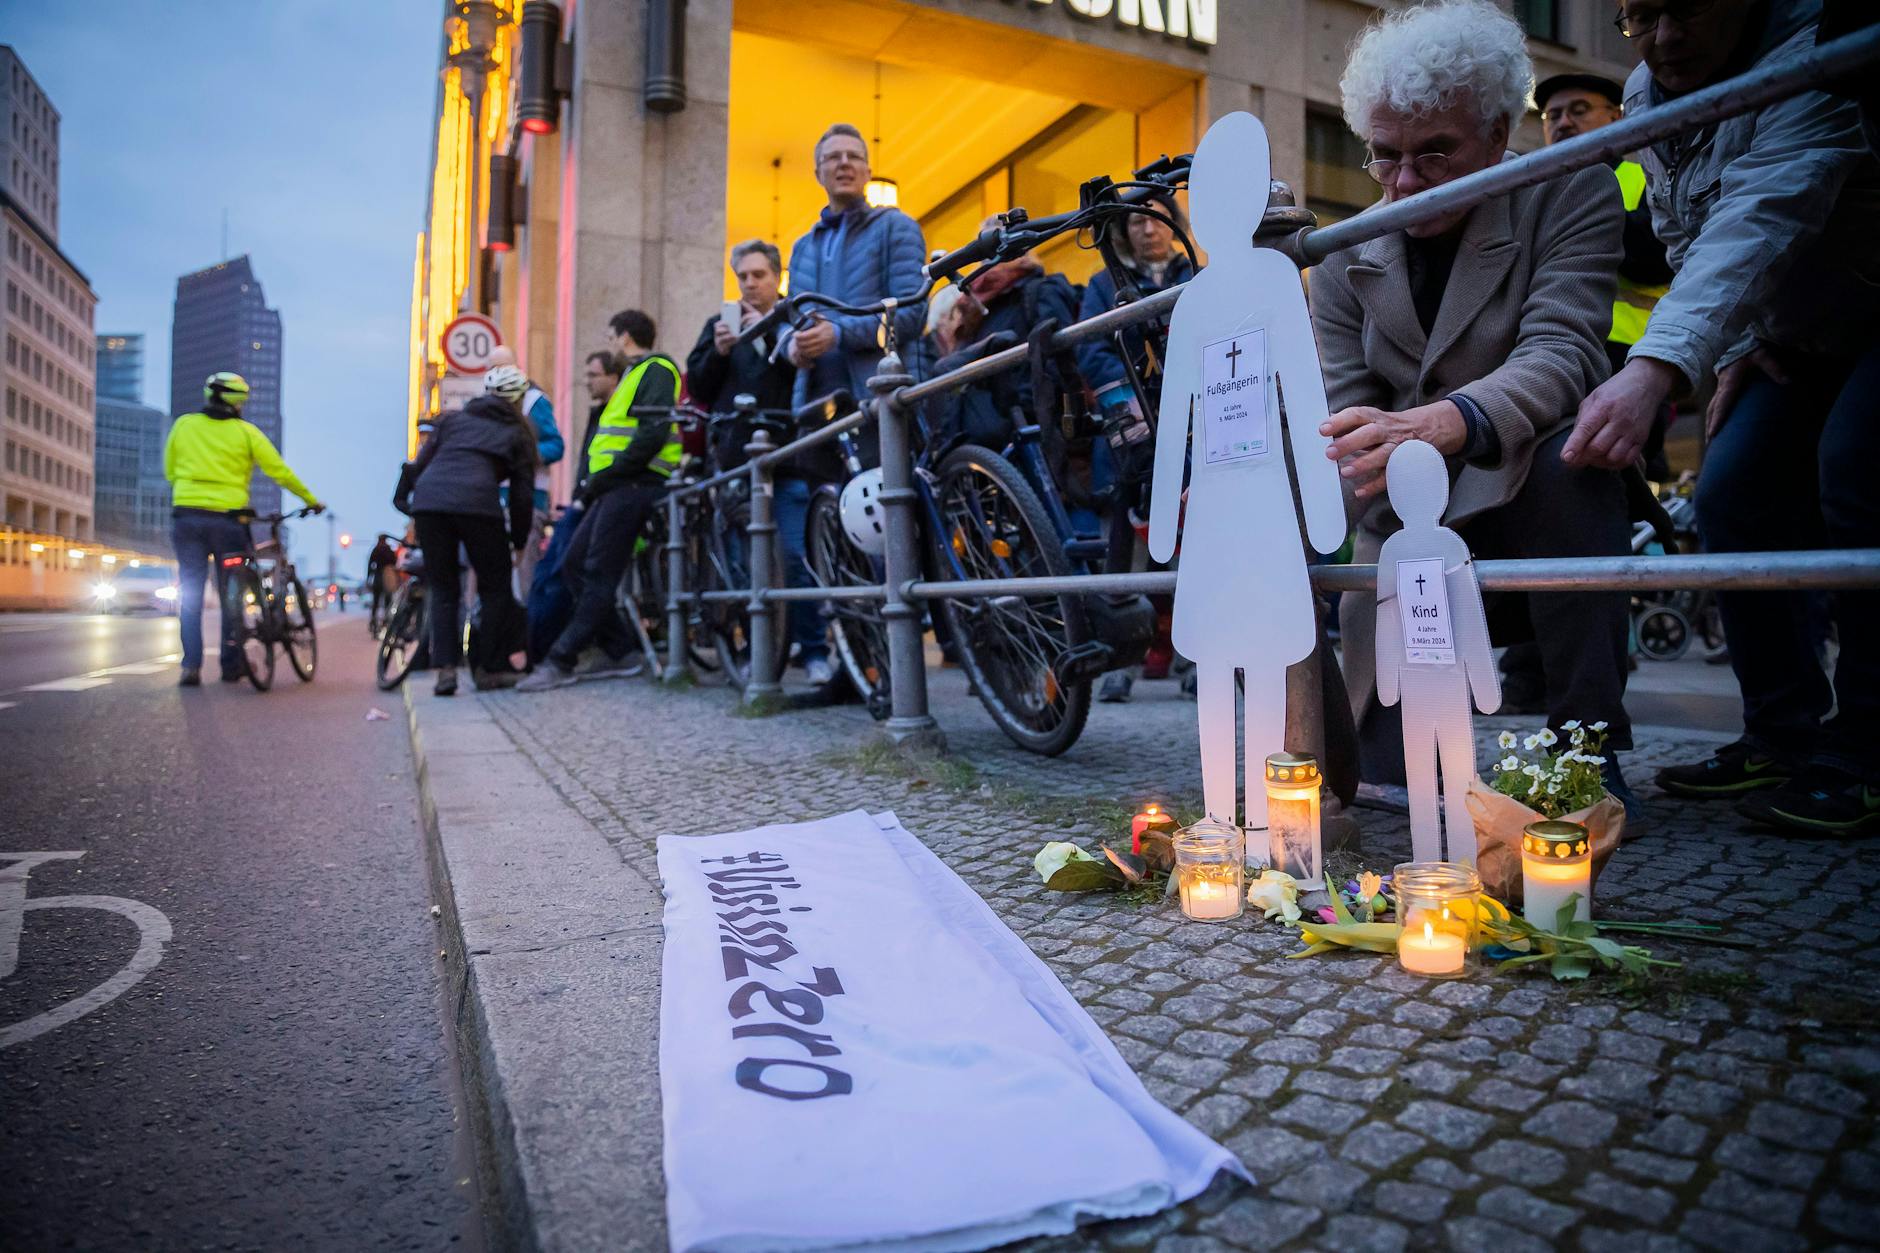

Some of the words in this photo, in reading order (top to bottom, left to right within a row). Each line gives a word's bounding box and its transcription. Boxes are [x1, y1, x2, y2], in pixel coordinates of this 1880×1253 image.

[455, 332, 490, 358] 30
[1207, 374, 1259, 396] Fußgängerin
[1230, 403, 1241, 411] Jahre
[1236, 411, 1247, 419] 2024
[1411, 604, 1438, 618] Kind
[700, 851, 853, 1101] #VisionZero
